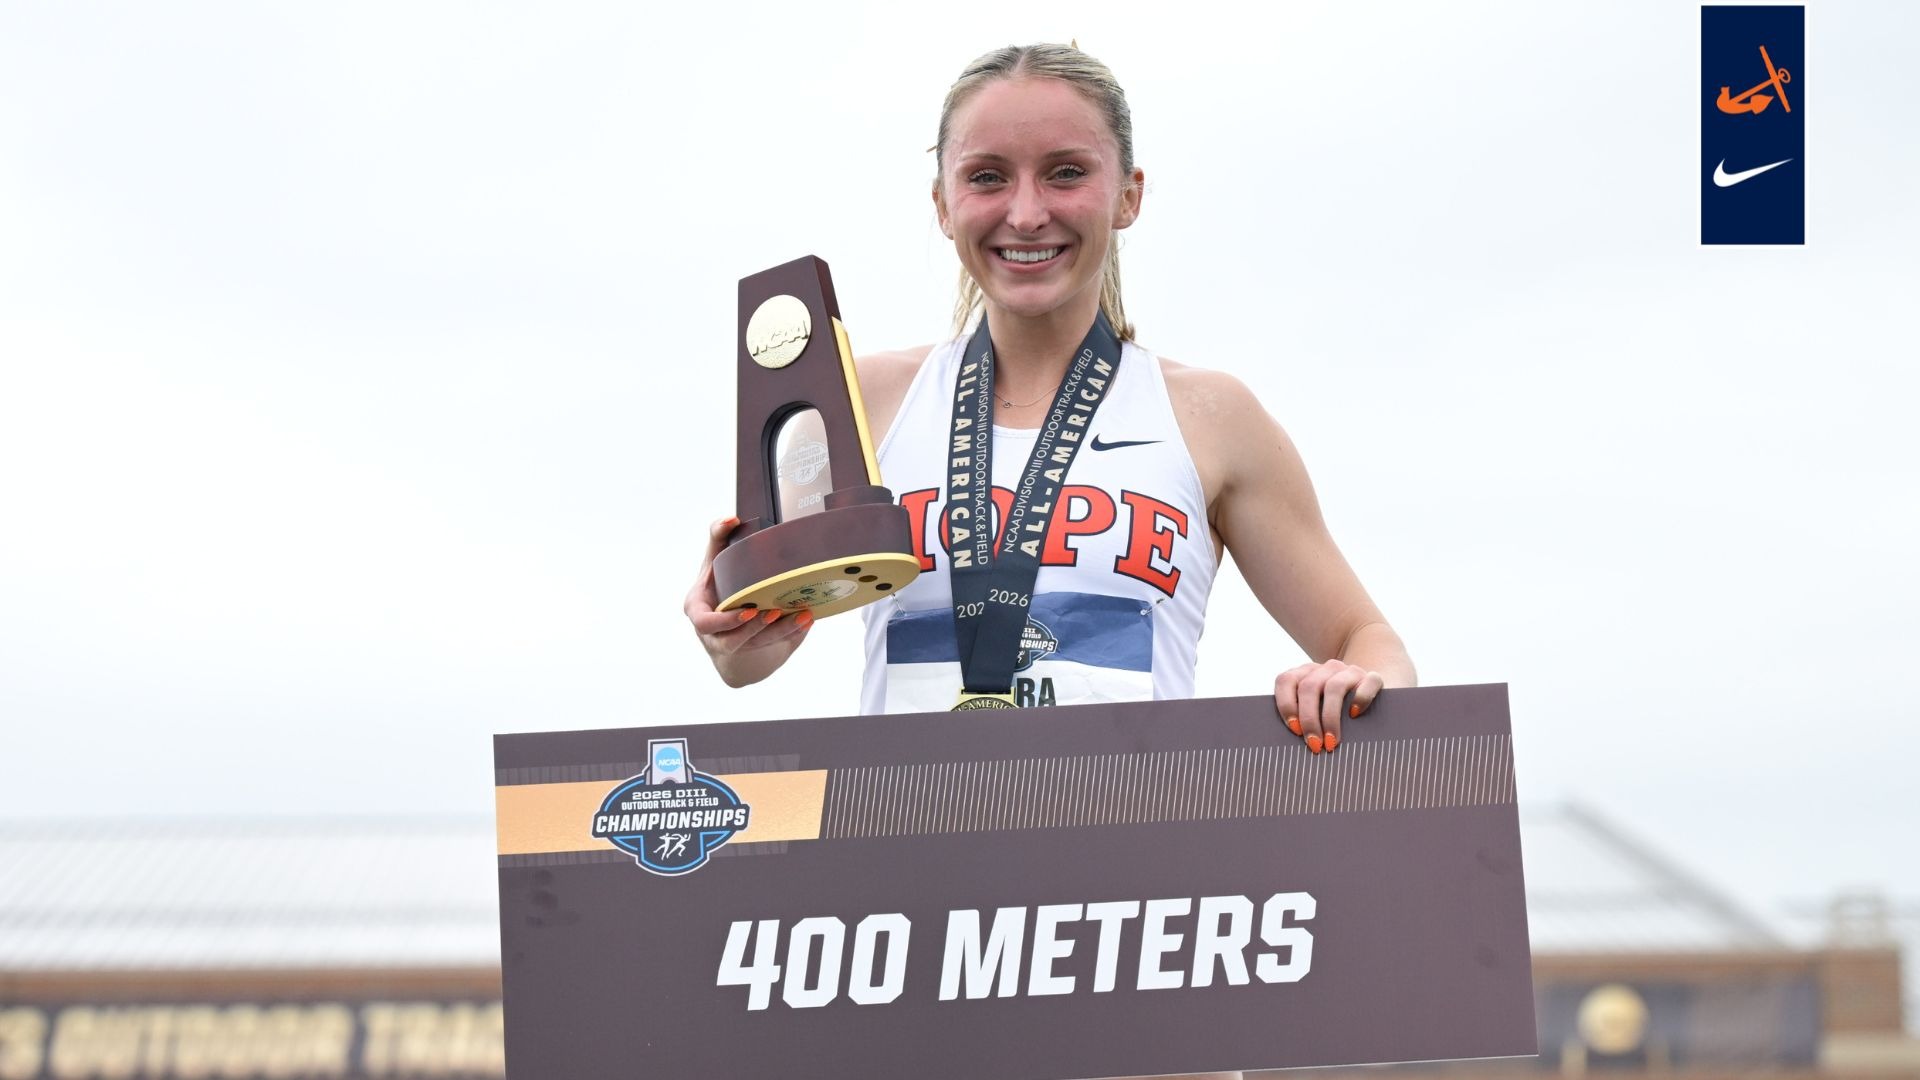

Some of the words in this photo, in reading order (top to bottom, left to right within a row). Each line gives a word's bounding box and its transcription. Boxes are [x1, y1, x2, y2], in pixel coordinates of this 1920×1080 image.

[1074, 348, 1093, 375] FIELD
[979, 377, 988, 422] DIVISION
[1057, 379, 1079, 409] TRACK
[1036, 407, 1065, 459] OUTDOOR
[952, 363, 978, 568] ALL-AMERICAN
[976, 433, 987, 486] OUTDOOR
[1021, 358, 1112, 557] ALL-AMERICAN
[1034, 460, 1044, 469] III
[798, 492, 822, 509] 2026
[976, 487, 986, 522] TRACK
[1013, 469, 1037, 517] DIVISION
[976, 524, 985, 532] &
[1003, 519, 1021, 553] NCAA
[977, 534, 988, 565] FIELD
[957, 601, 985, 619] 202
[988, 588, 1029, 607] 2026
[1017, 677, 1057, 708] RA
[621, 800, 659, 811] OUTDOOR
[660, 798, 688, 809] TRACK
[688, 798, 694, 807] &
[696, 797, 719, 807] FIELD
[632, 790, 672, 800] 2026
[676, 788, 707, 798] DIII
[595, 808, 746, 833] CHAMPIONSHIPS
[716, 912, 911, 1011] 400
[938, 891, 1317, 1001] METERS
